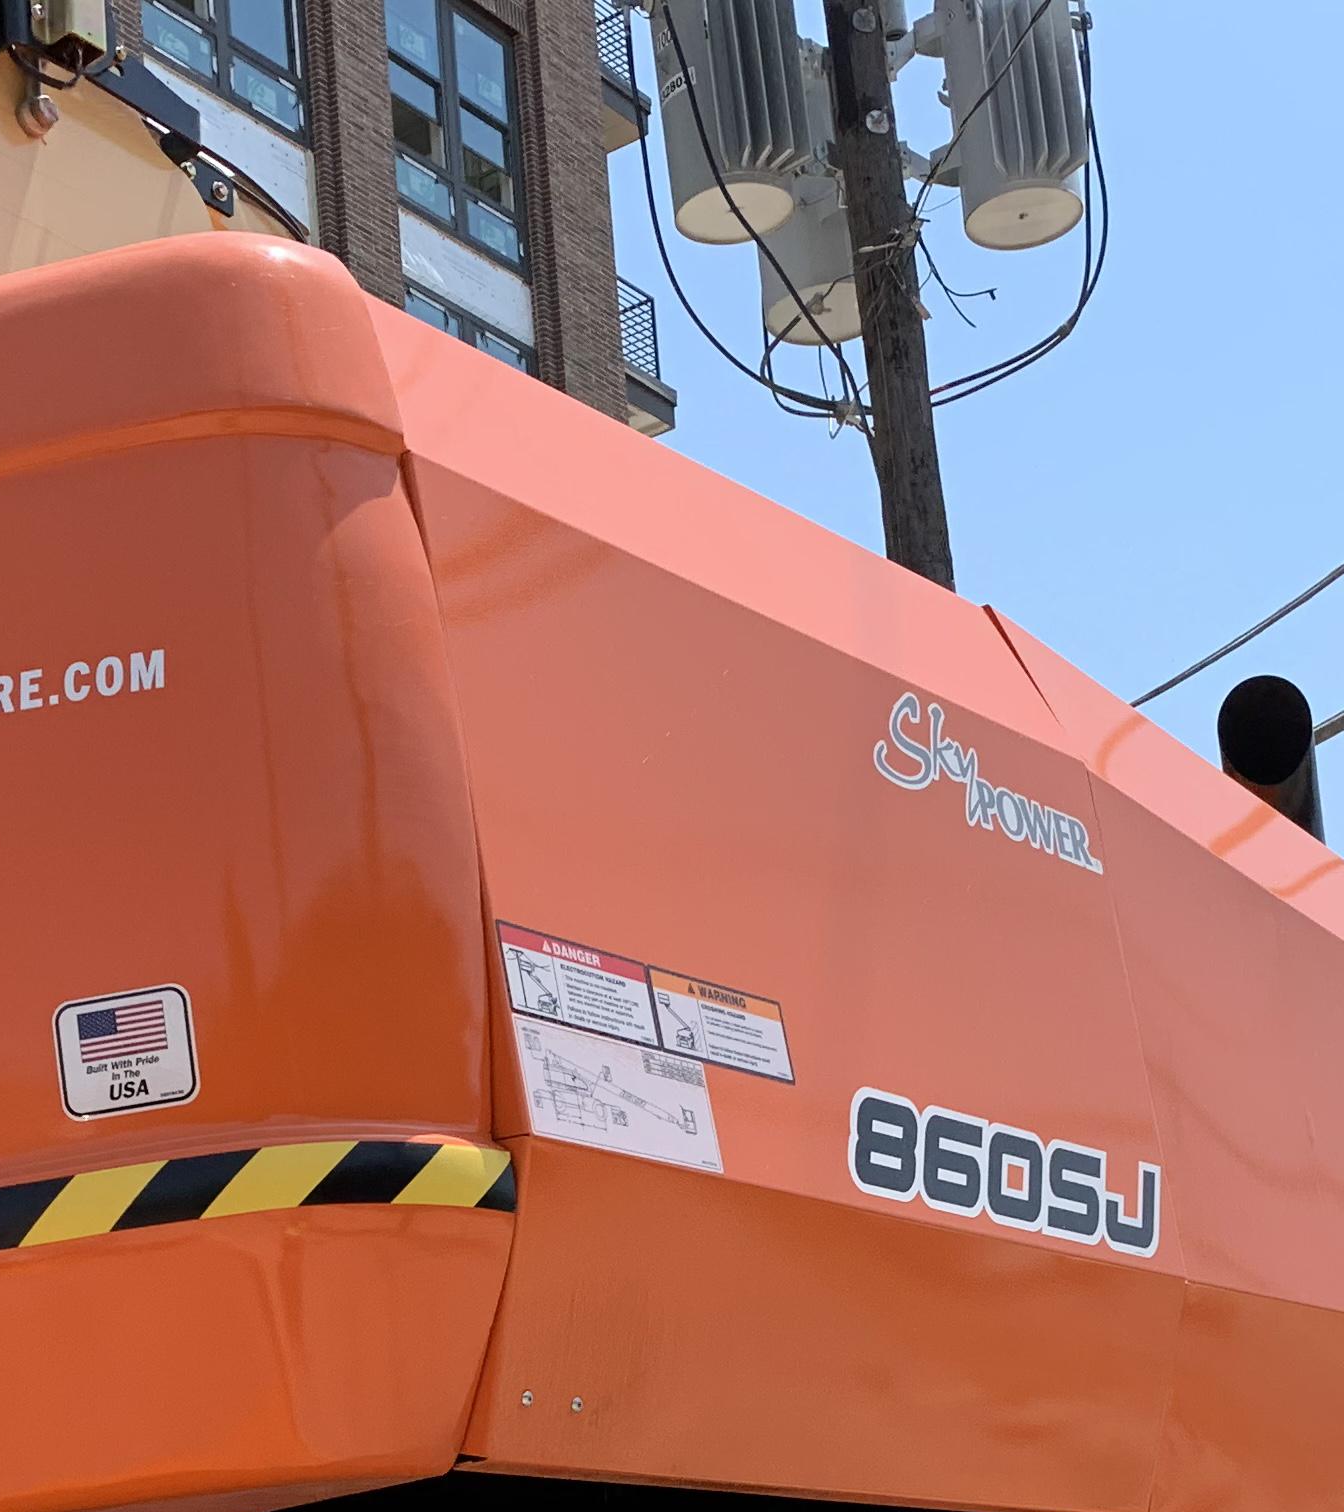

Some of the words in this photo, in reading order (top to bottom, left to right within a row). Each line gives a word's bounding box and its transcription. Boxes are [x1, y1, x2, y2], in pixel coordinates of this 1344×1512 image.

[551, 942, 602, 968] DANGER
[697, 984, 747, 1009] WARNING
[86, 1063, 109, 1075] Built
[111, 1058, 133, 1070] With
[135, 1055, 160, 1067] Pride
[112, 1071, 121, 1081] In
[124, 1069, 141, 1079] The
[109, 1079, 150, 1102] USA
[851, 1090, 1159, 1255] 860SJ
